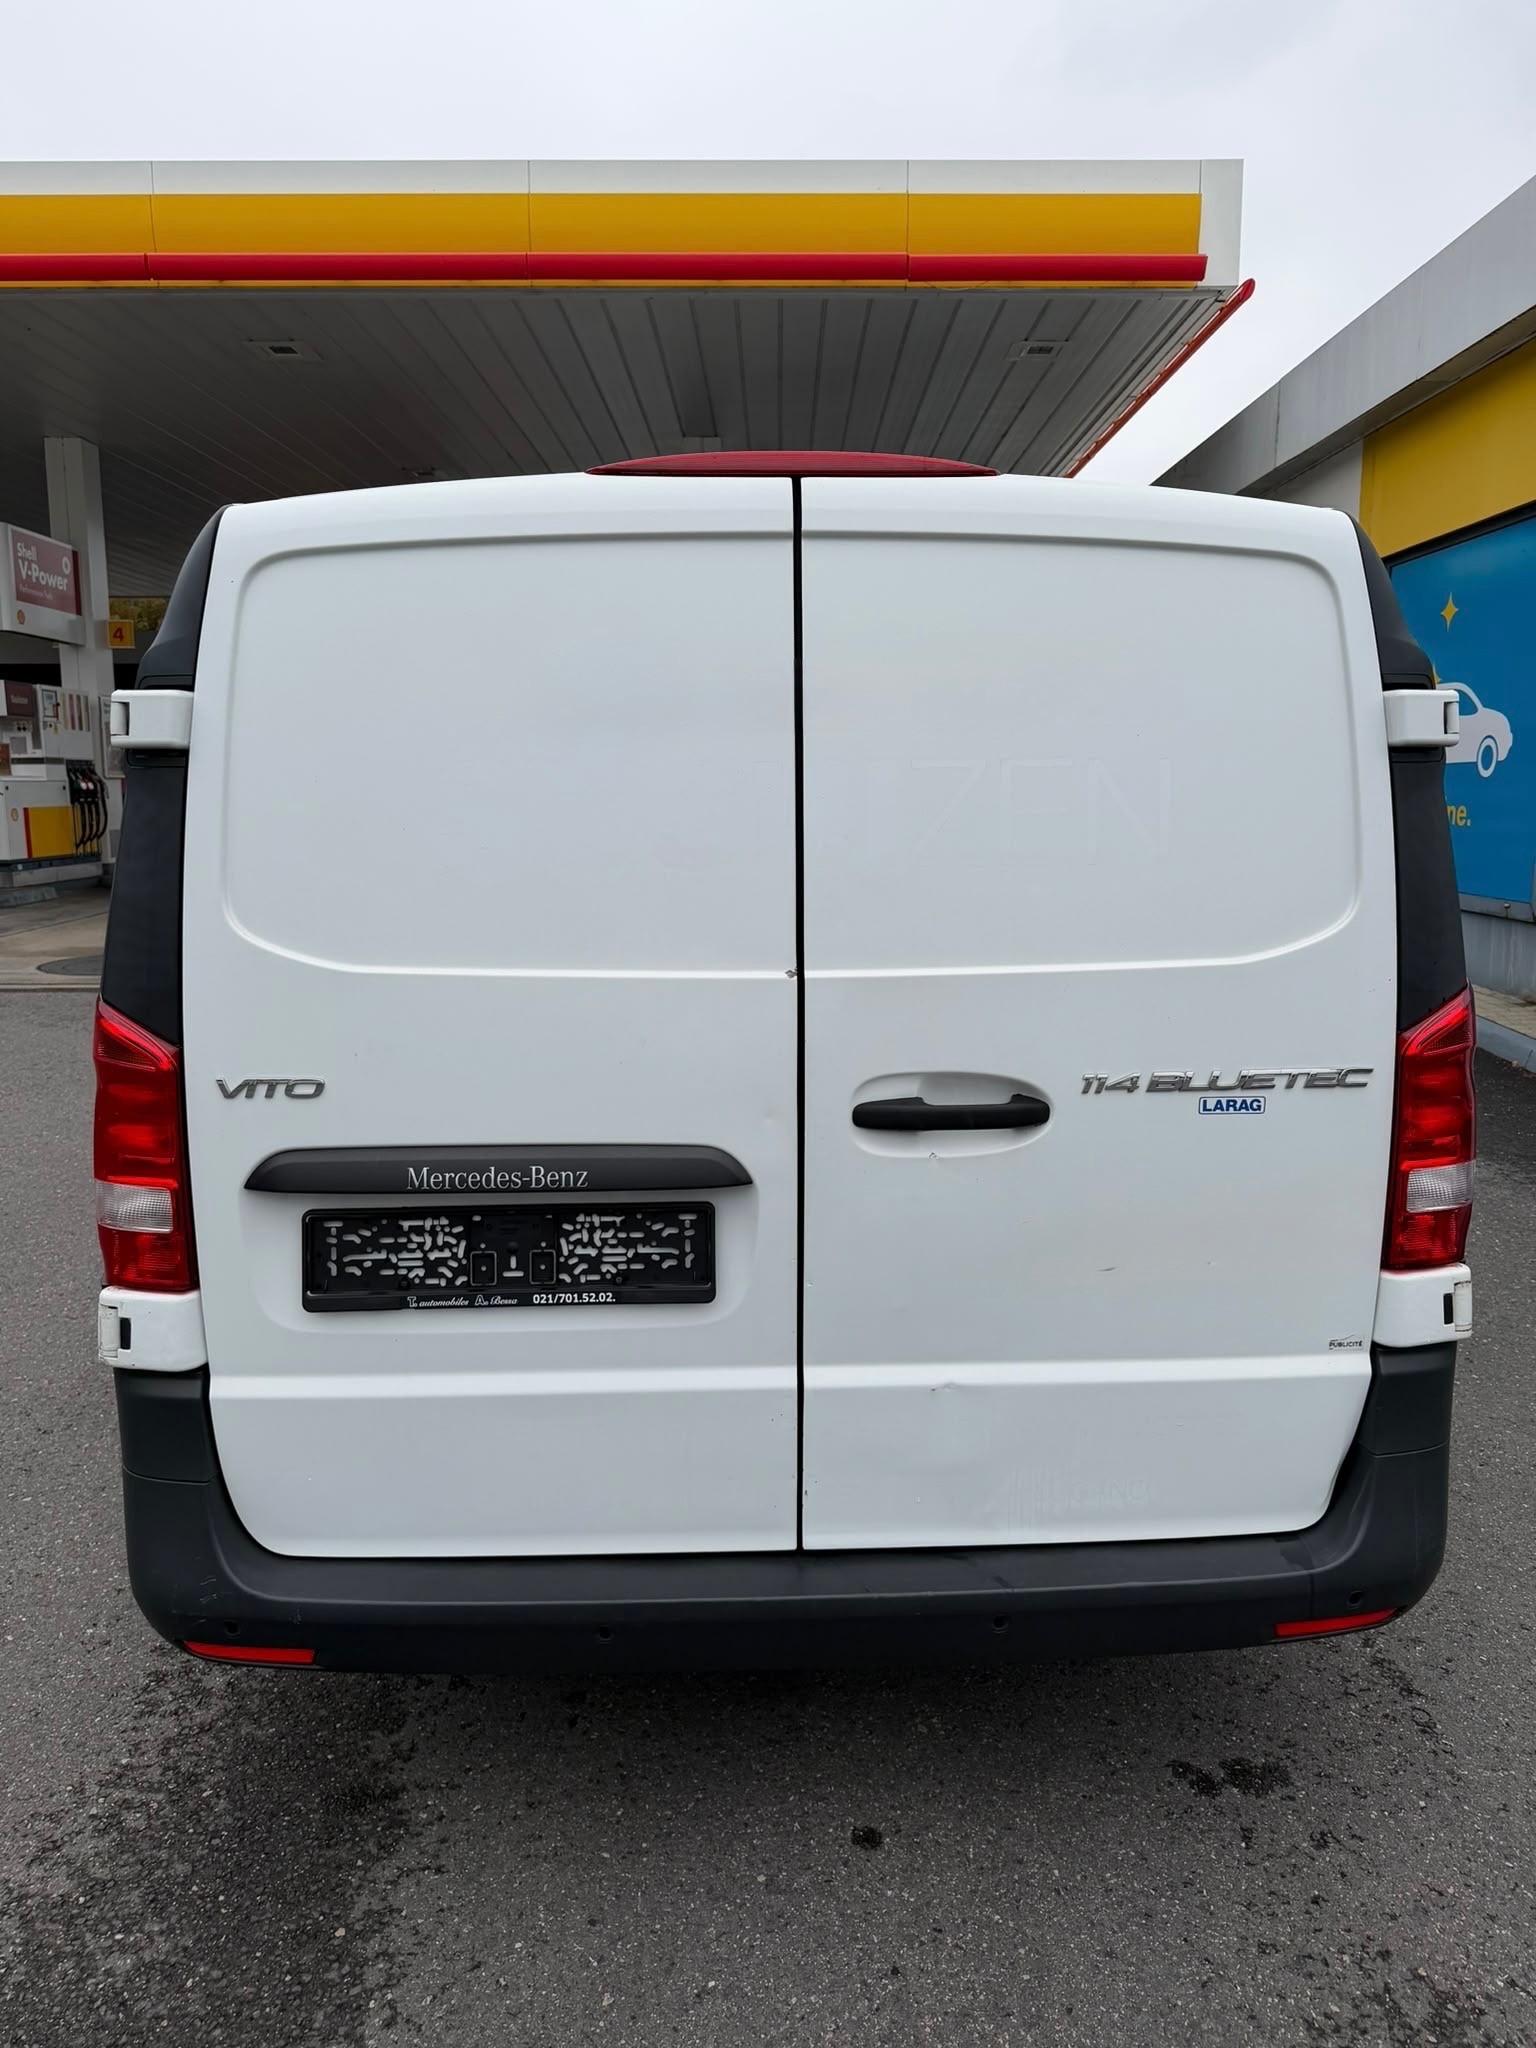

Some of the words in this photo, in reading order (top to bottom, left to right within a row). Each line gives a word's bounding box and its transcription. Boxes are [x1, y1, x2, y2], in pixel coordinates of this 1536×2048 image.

[17, 542, 37, 561] Shell
[18, 559, 68, 591] V-Power
[112, 627, 125, 642] 4
[215, 1078, 325, 1100] VITO
[1081, 1072, 1140, 1094] 114
[1146, 1067, 1374, 1093] BLUETEC
[1202, 1098, 1263, 1112] LARAG
[406, 1165, 589, 1190] Mercedes-Benz
[419, 1296, 470, 1307] automobiles
[532, 1292, 617, 1304] 021/701.52.02.
